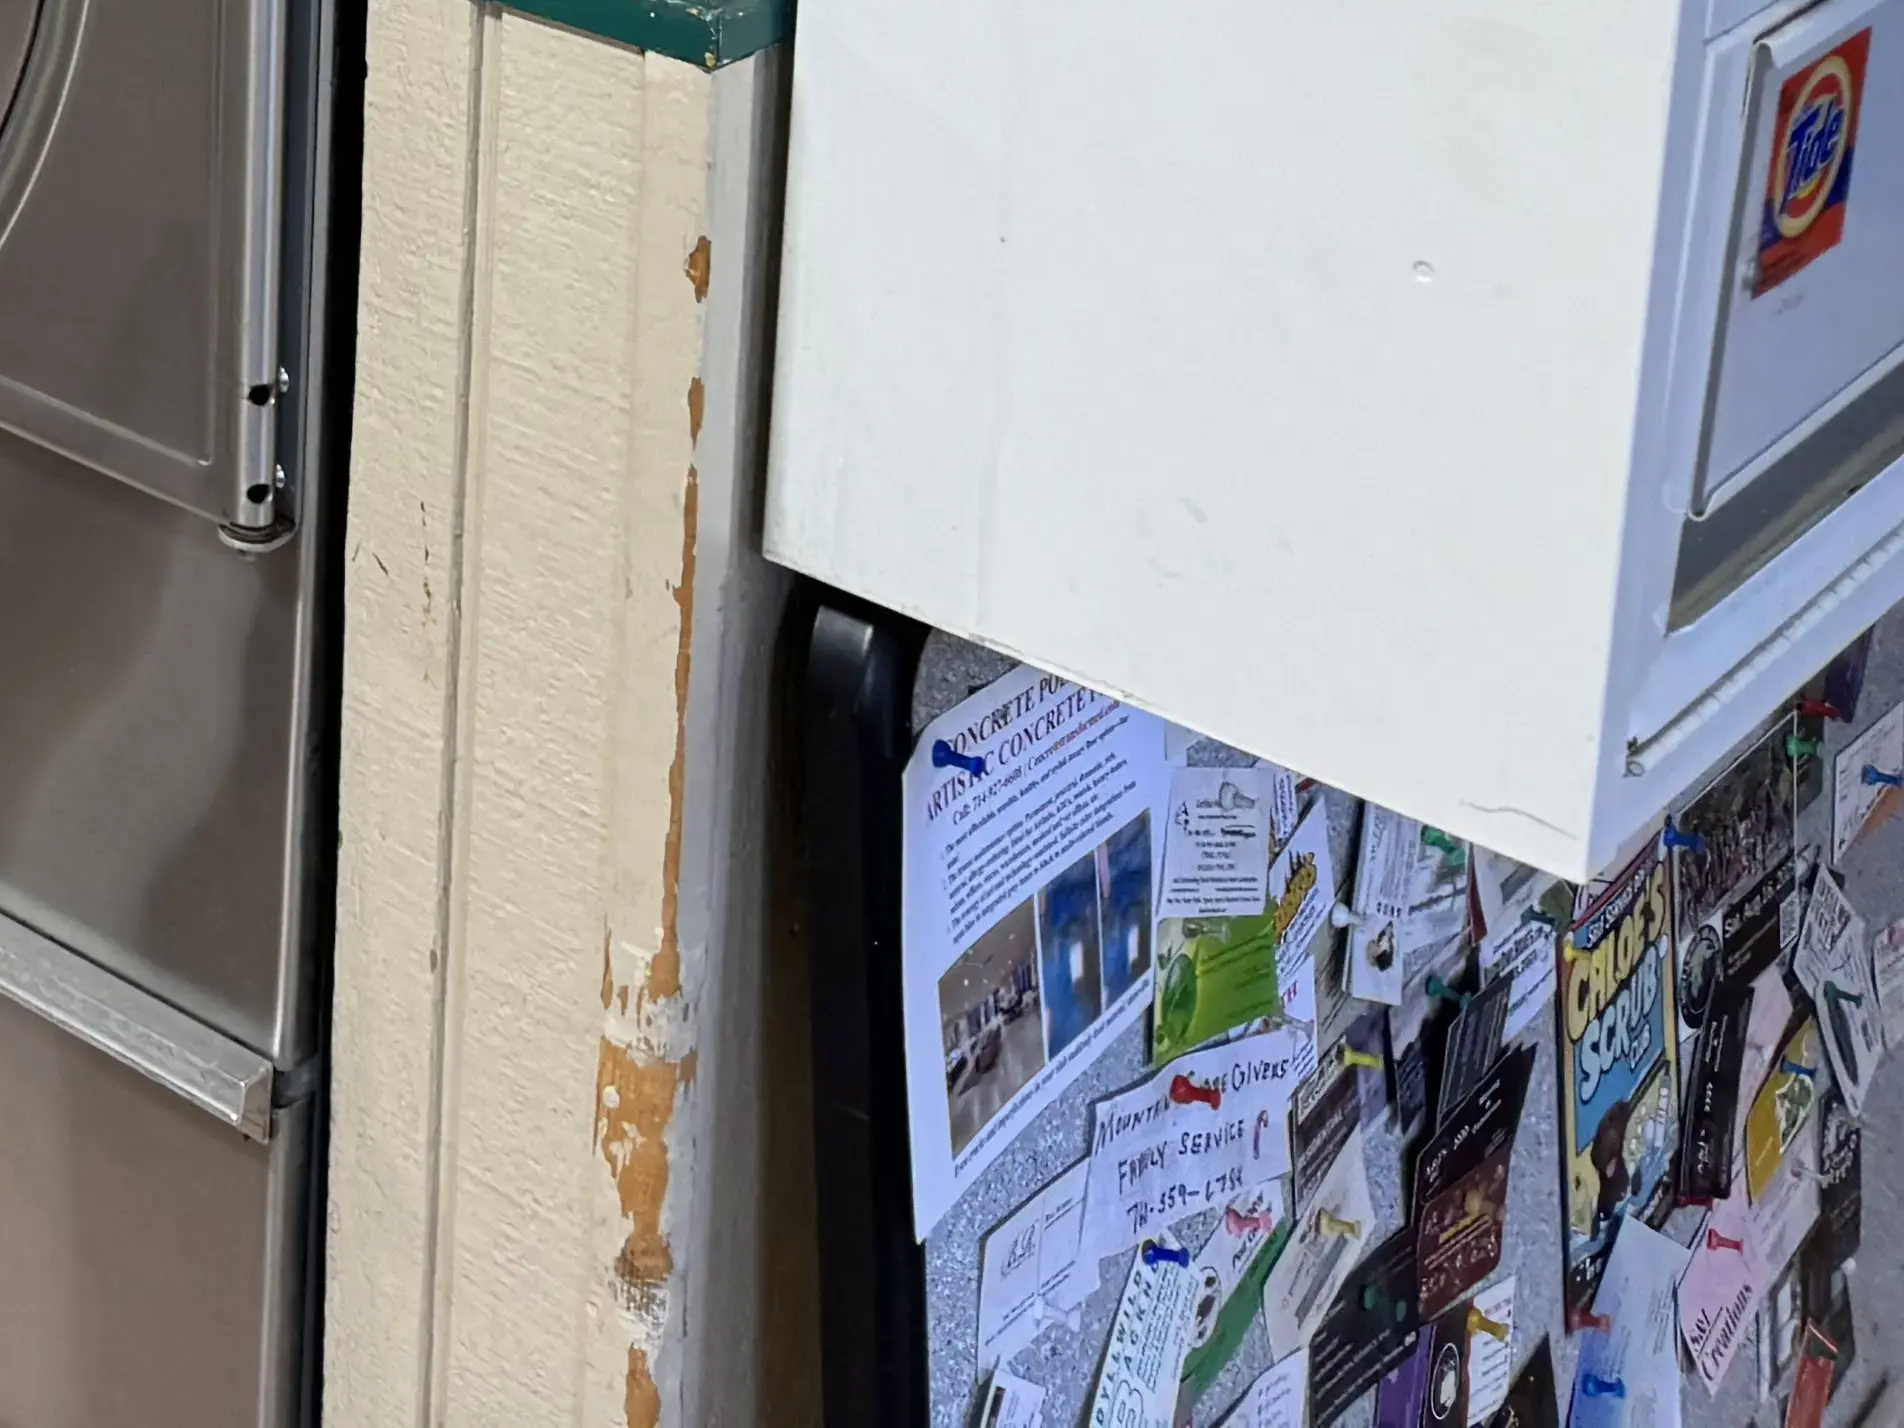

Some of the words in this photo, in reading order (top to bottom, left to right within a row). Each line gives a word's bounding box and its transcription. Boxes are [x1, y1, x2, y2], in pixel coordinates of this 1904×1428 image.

[1787, 97, 1847, 202] Tide
[949, 685, 1036, 754] ONCRETE
[998, 687, 1087, 766] CONCRETE
[1579, 945, 1659, 1104] SCRUB
